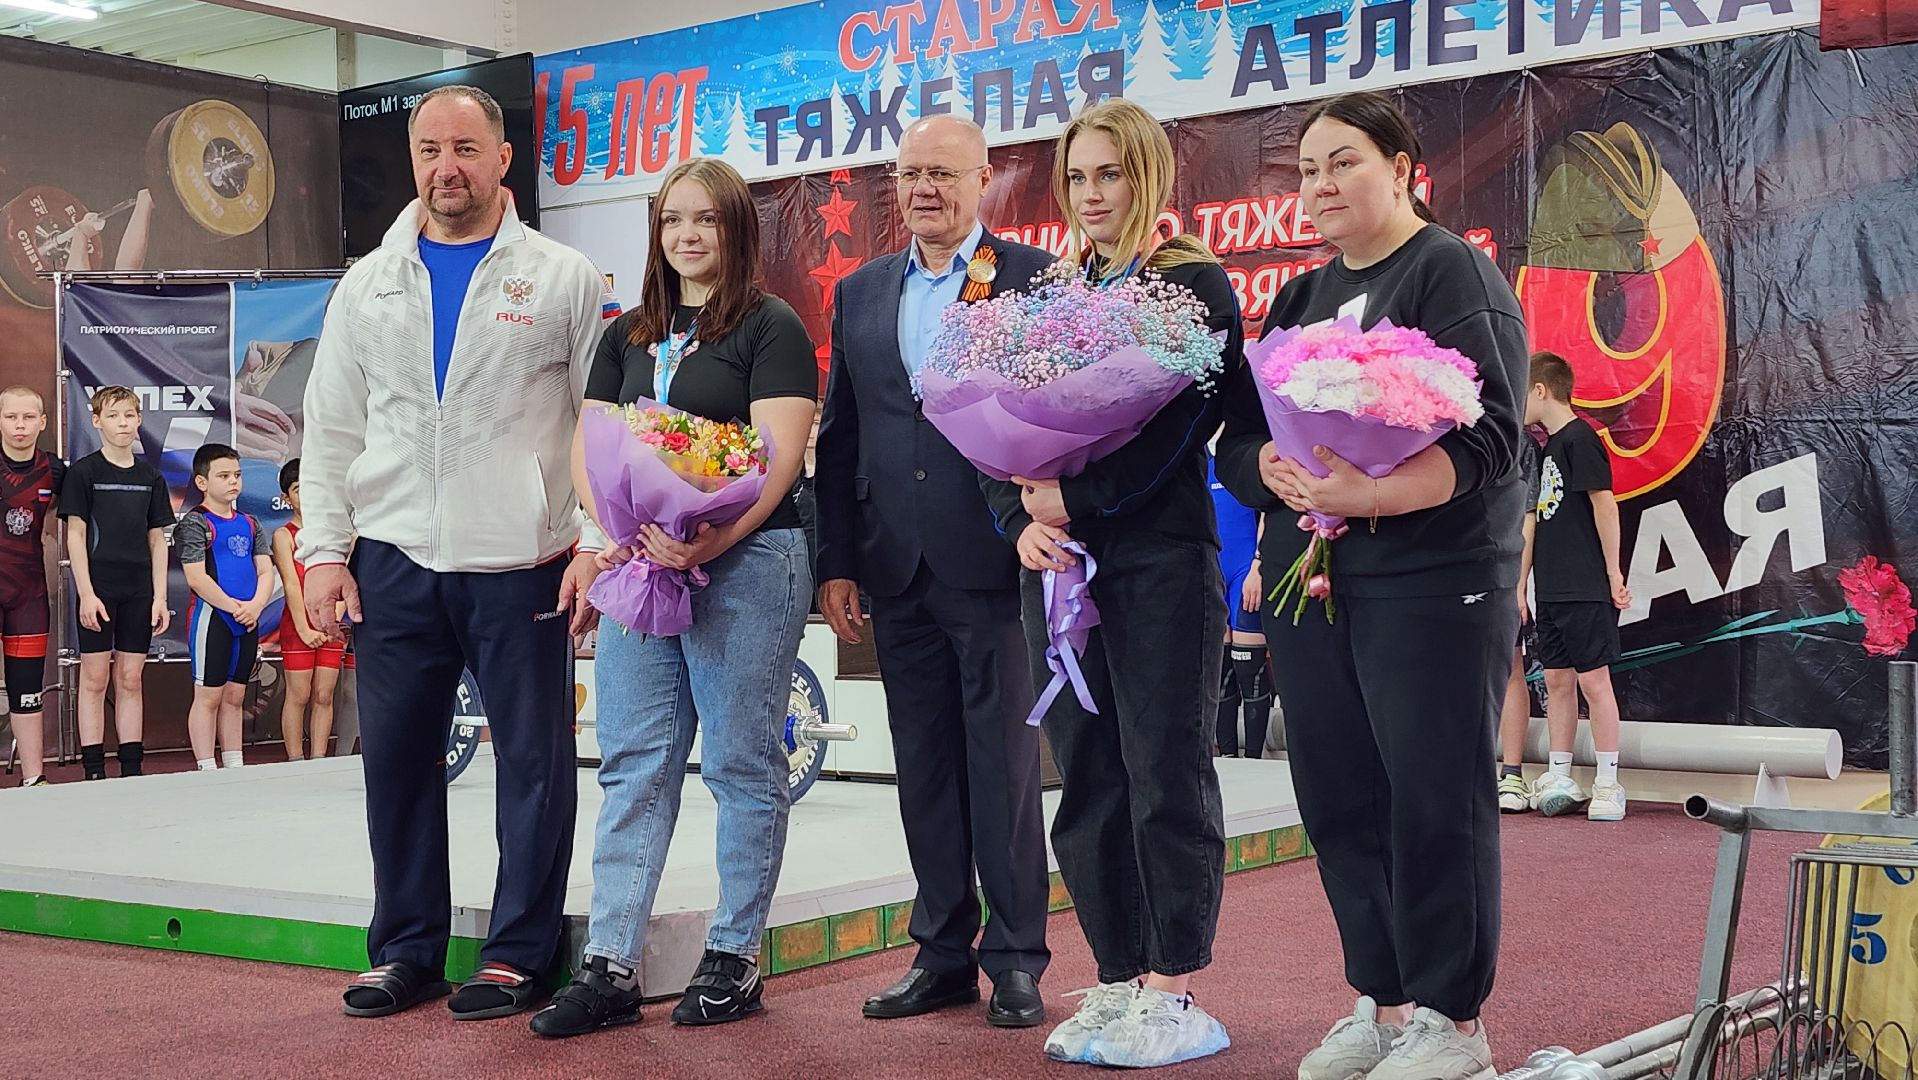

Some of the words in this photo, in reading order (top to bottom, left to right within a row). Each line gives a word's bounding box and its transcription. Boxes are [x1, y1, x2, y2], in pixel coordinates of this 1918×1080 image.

[344, 102, 379, 121] Поток
[495, 312, 534, 326] RUS
[80, 324, 176, 335] ПАТРИОТИЧЕСКИЙ
[177, 325, 217, 335] ПРОЕКТ
[1528, 452, 1827, 627] АЯ
